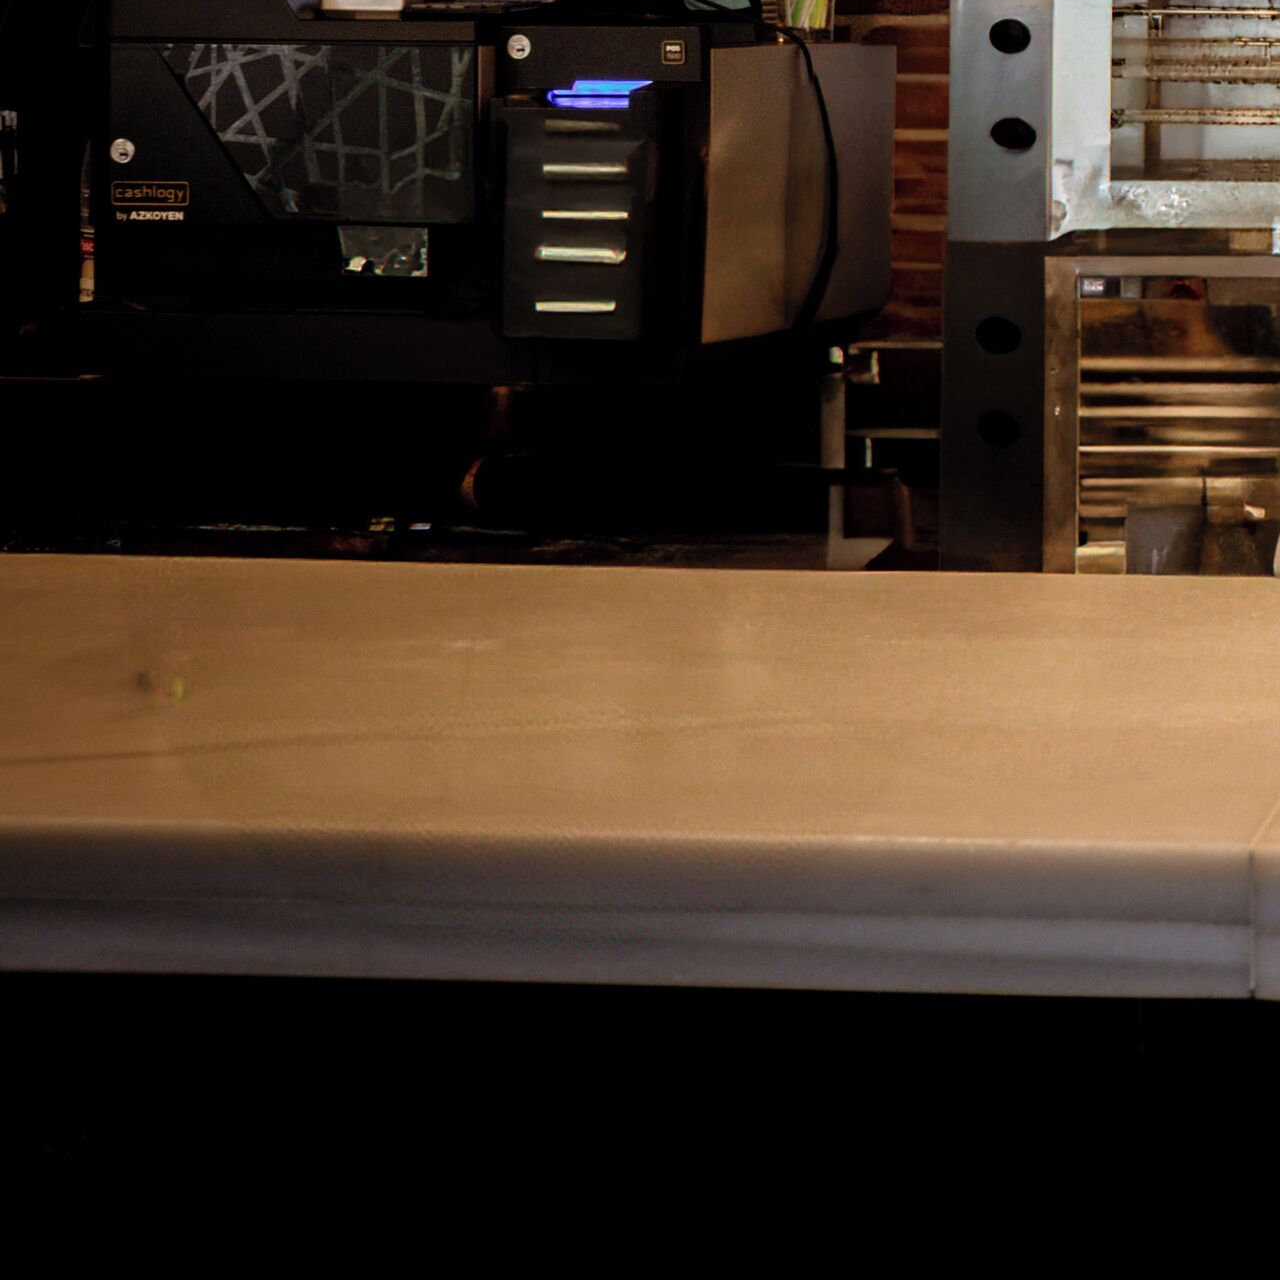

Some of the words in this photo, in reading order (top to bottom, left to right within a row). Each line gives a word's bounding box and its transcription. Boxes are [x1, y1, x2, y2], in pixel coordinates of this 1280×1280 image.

[114, 185, 185, 203] cashlogy
[116, 211, 128, 222] by
[129, 210, 185, 221] AZKOYEN
